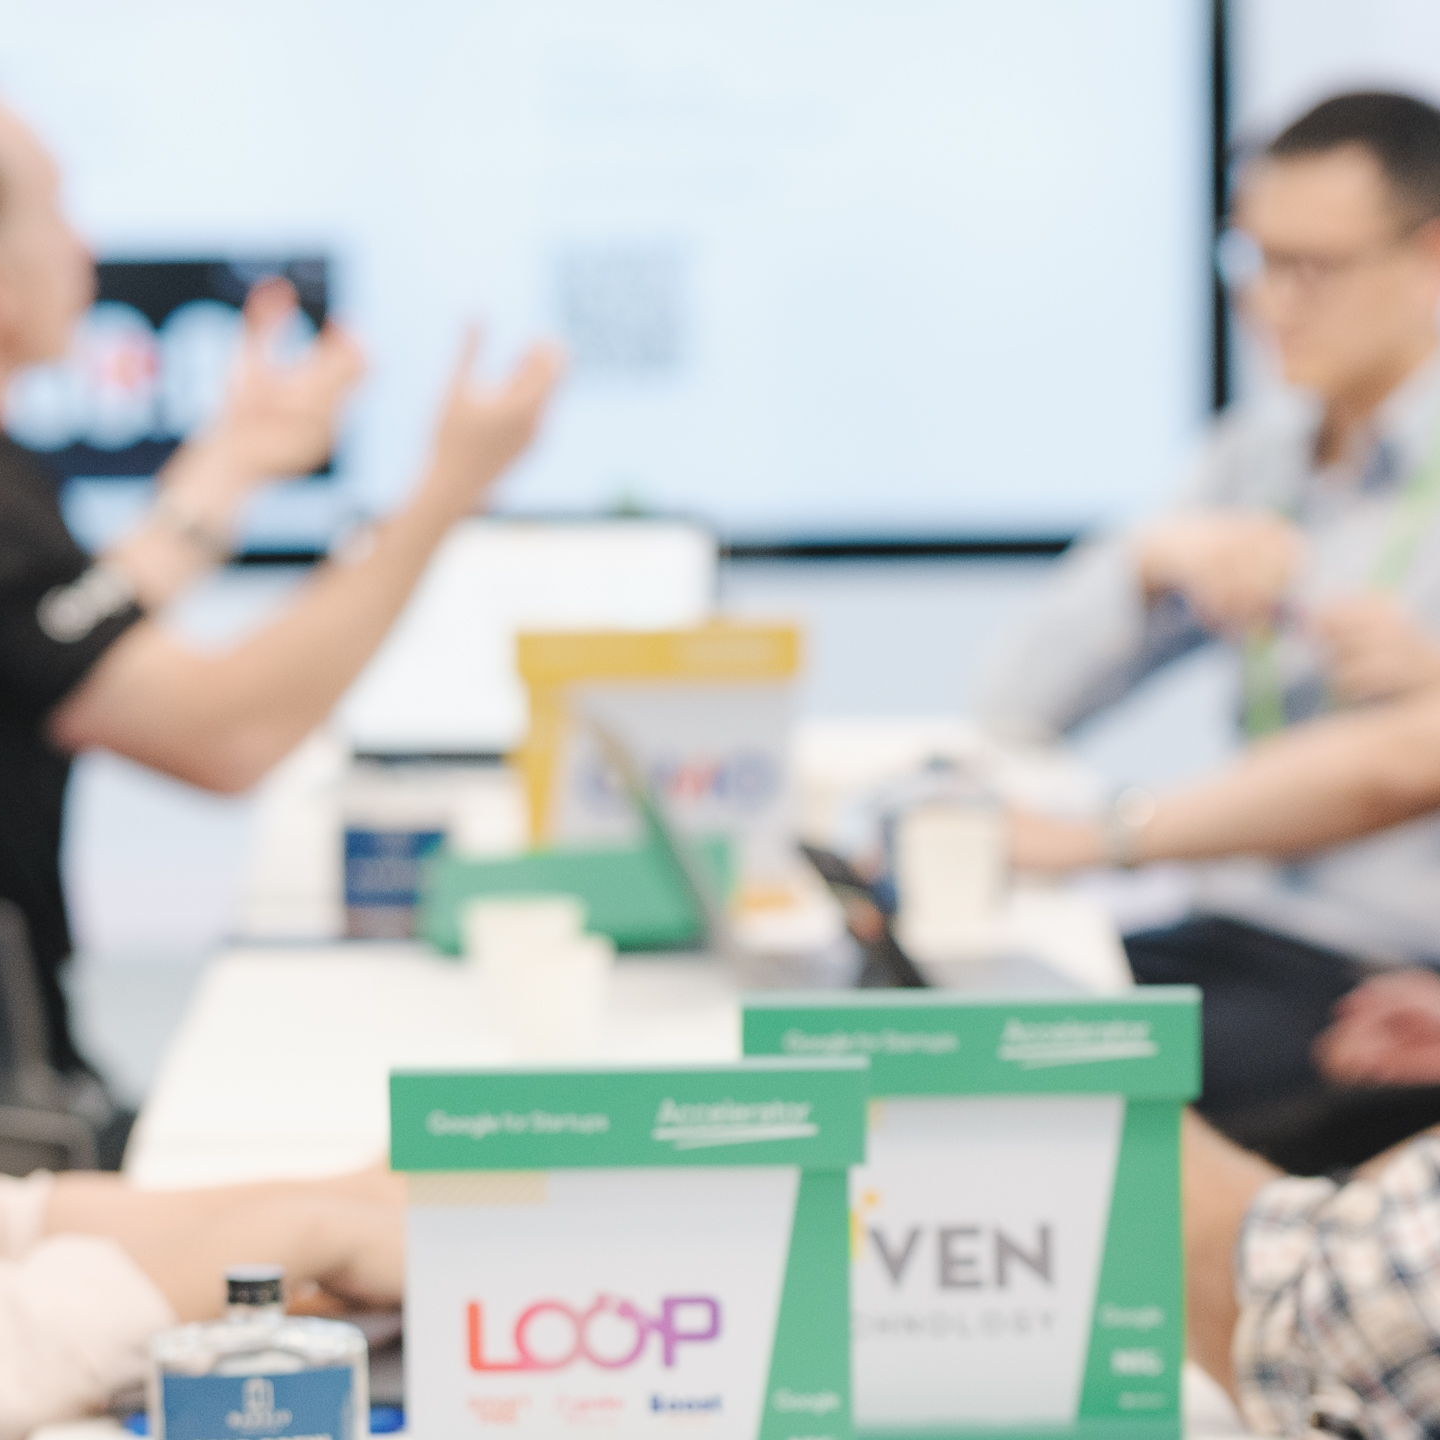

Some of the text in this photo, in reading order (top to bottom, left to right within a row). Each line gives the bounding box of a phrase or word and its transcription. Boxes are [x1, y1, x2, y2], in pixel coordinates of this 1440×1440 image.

[1004, 1018, 1150, 1044] Accelerator
[426, 1109, 499, 1140] Google
[532, 1109, 611, 1135] Startups
[656, 1098, 813, 1126] Accelerator
[467, 1292, 722, 1374] LOOP
